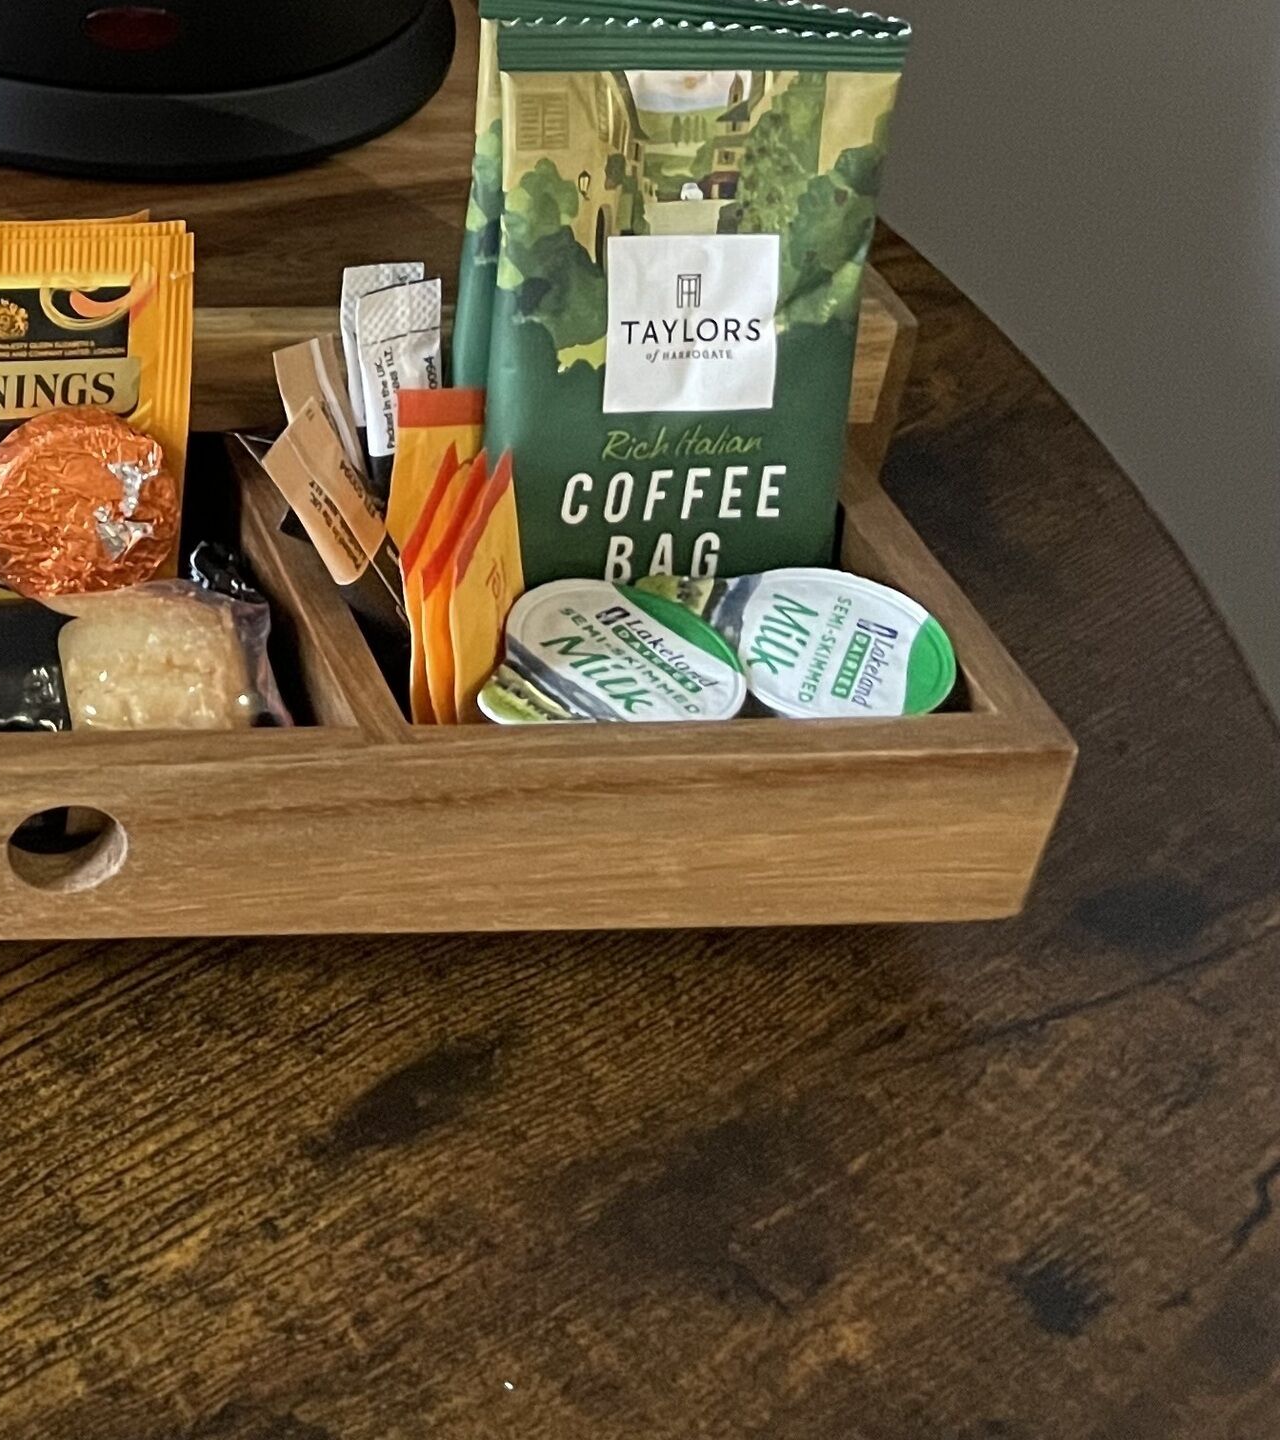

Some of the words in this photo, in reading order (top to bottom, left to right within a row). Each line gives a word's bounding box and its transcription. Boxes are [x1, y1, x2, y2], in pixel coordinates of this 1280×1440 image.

[620, 317, 762, 346] TAYLORS
[601, 426, 669, 460] Rich
[673, 423, 763, 459] Italian
[560, 464, 787, 526] COFFEE
[603, 531, 721, 583] BAG
[559, 607, 701, 714] SEMI-SKIMMED
[626, 618, 720, 688] Lakeland
[746, 593, 819, 675] Milk
[798, 596, 853, 703] SEMI-SKIMMED
[540, 635, 654, 715] Milk
[851, 640, 895, 710] Lakeland
